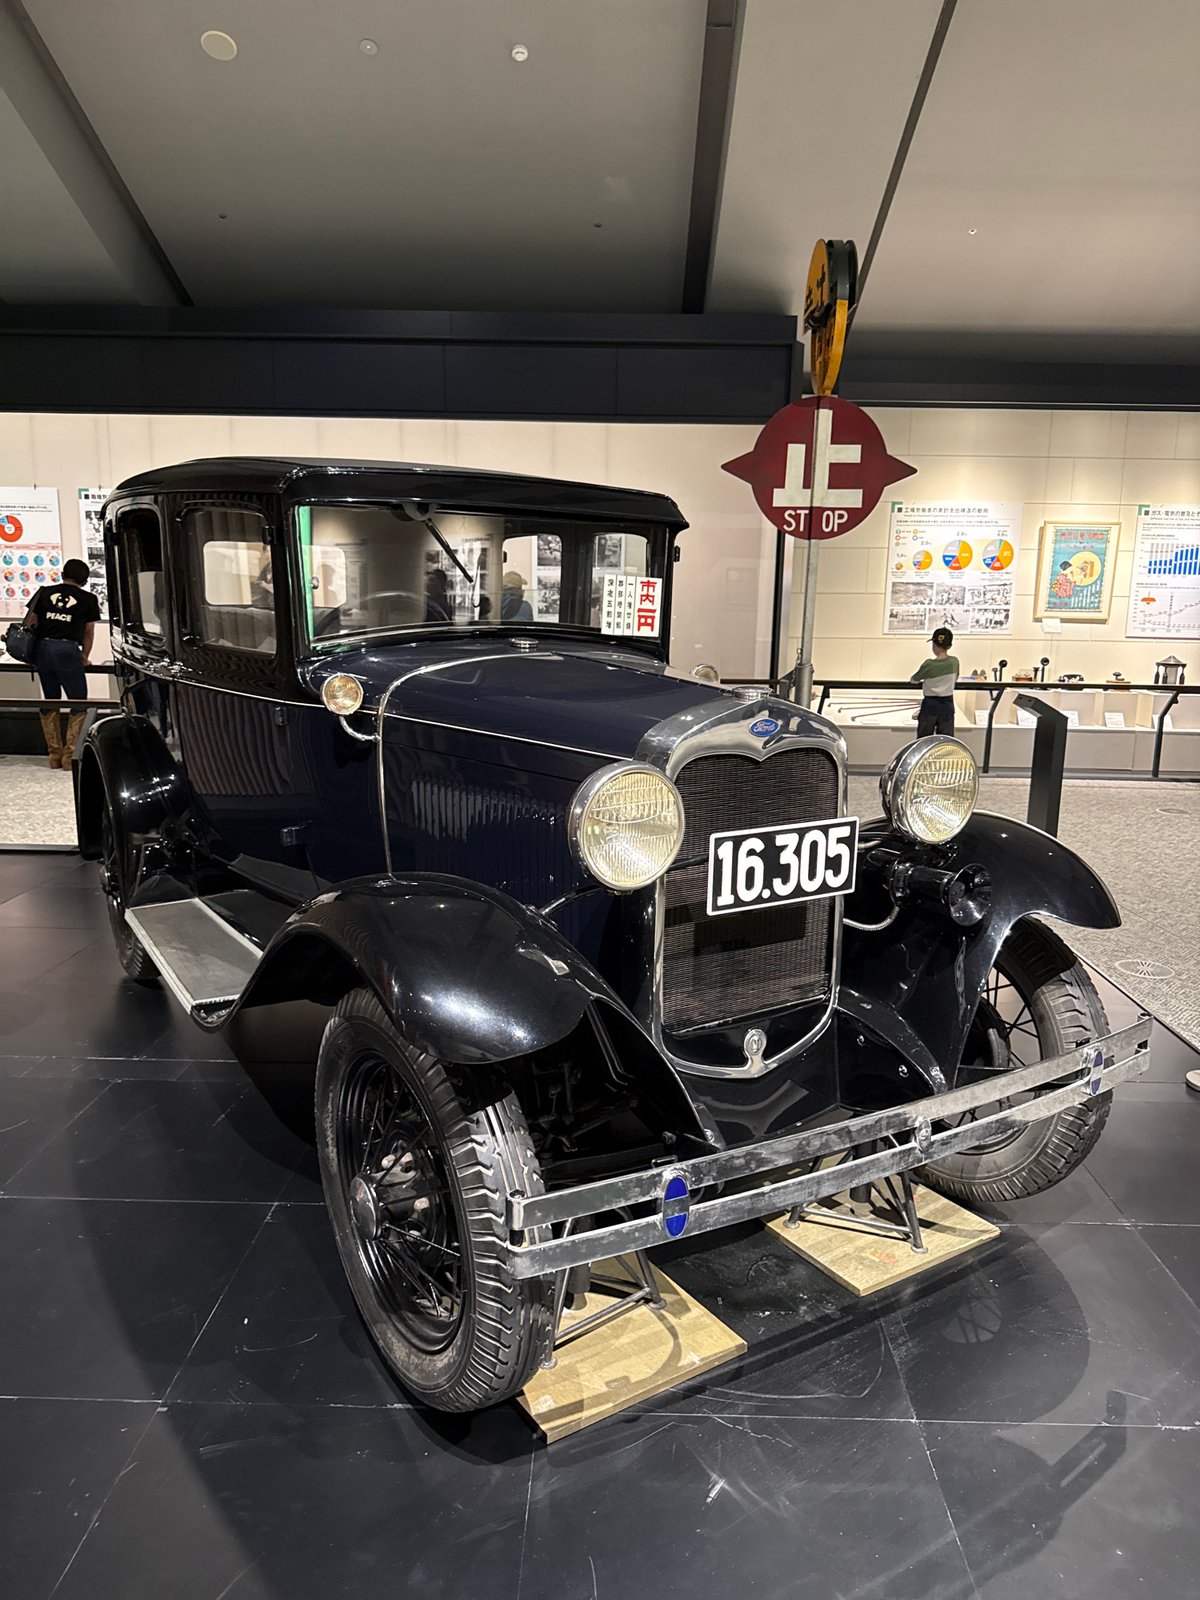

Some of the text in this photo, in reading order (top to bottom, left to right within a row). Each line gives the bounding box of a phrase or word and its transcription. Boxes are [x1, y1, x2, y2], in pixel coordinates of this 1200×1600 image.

[772, 408, 863, 508] 止
[46, 611, 73, 623] PEACE
[637, 580, 657, 632] 市内一円
[752, 720, 777, 734] Ford
[716, 825, 851, 906] 16.305
